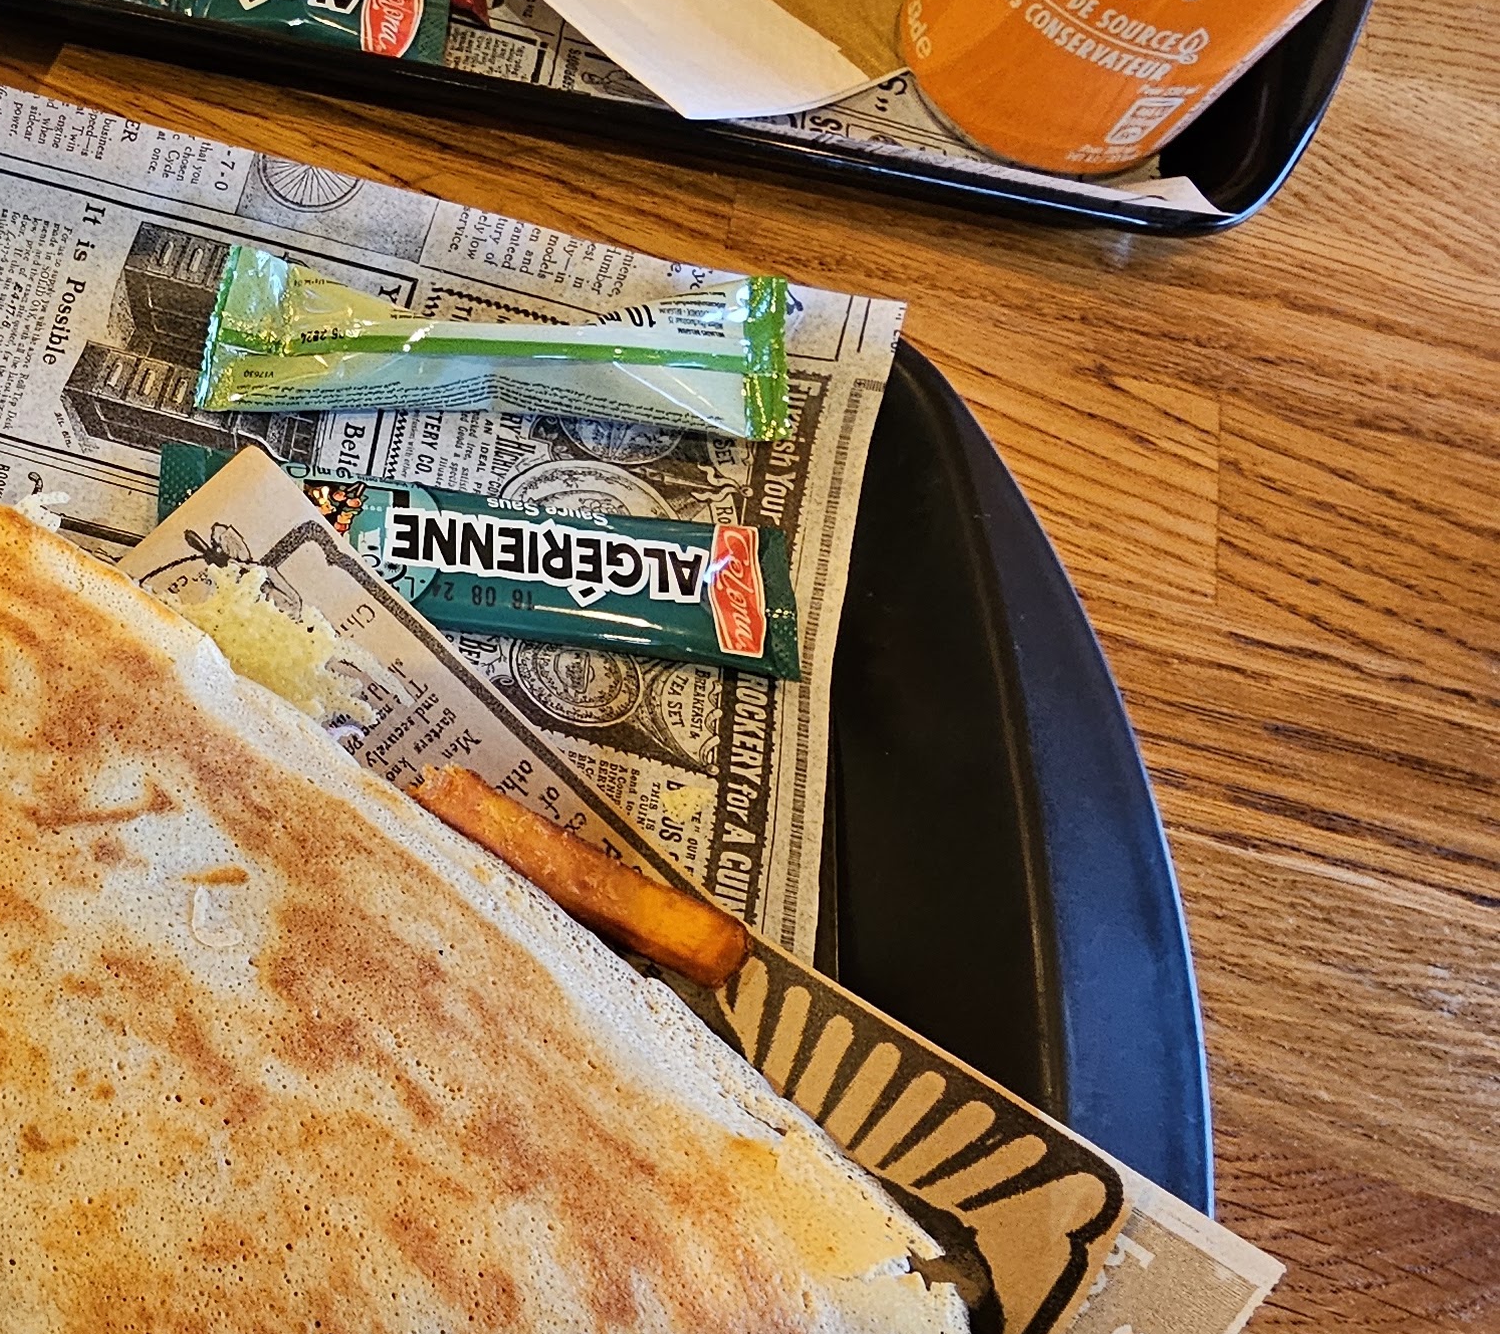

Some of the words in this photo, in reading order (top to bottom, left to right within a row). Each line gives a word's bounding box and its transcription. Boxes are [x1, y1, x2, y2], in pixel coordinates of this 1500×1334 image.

[1095, 8, 1184, 58] SOURCE
[82, 202, 107, 226] It
[73, 238, 96, 262] is
[42, 276, 87, 365] Possible
[759, 472, 796, 526] Your
[391, 512, 709, 605] ALGÉRIENNE
[729, 678, 768, 782] ROCKERY
